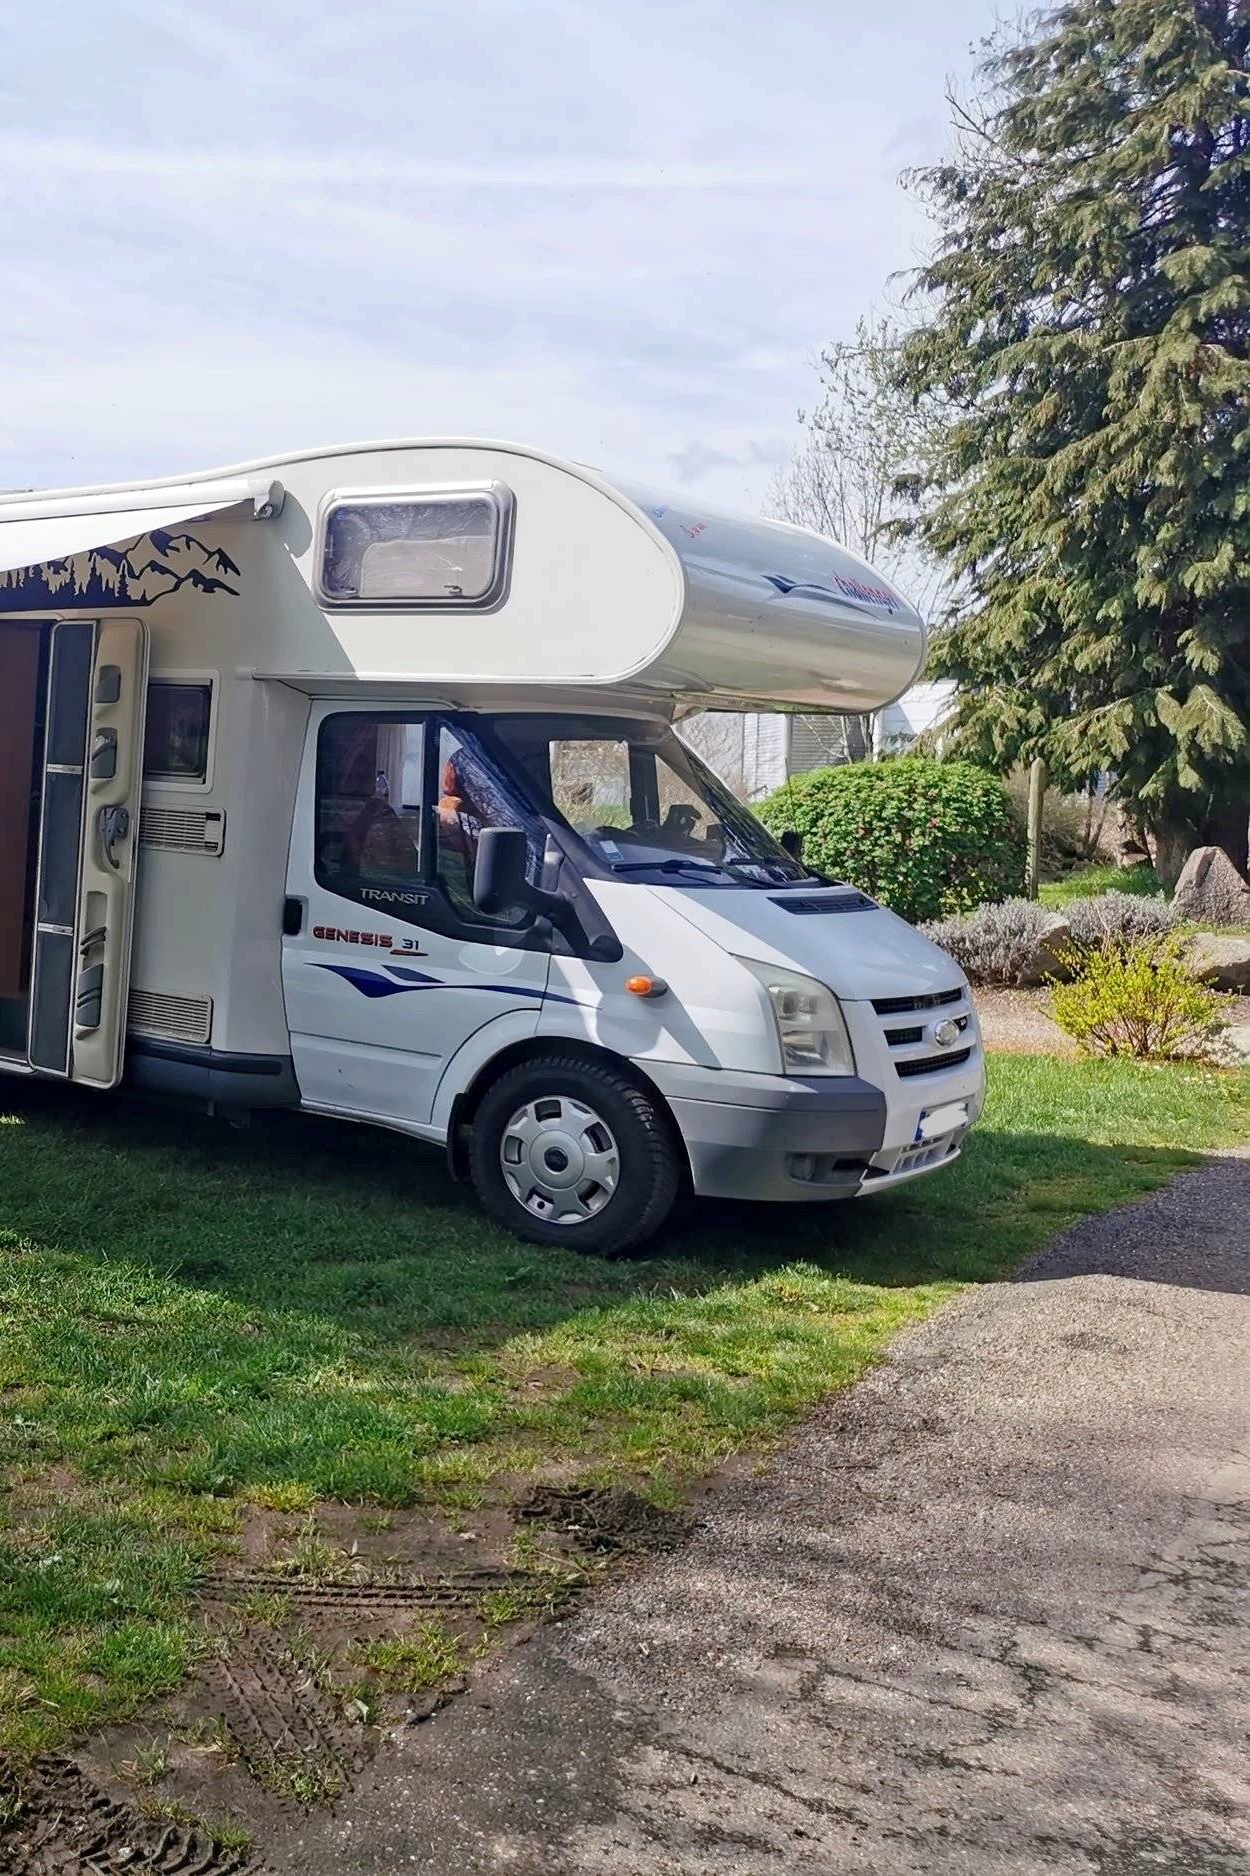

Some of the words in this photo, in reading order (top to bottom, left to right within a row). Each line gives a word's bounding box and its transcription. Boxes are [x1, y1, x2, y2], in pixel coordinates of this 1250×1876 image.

[359, 887, 429, 906] TRANSIT
[312, 925, 393, 948] GENESIS
[402, 938, 420, 951] 31
